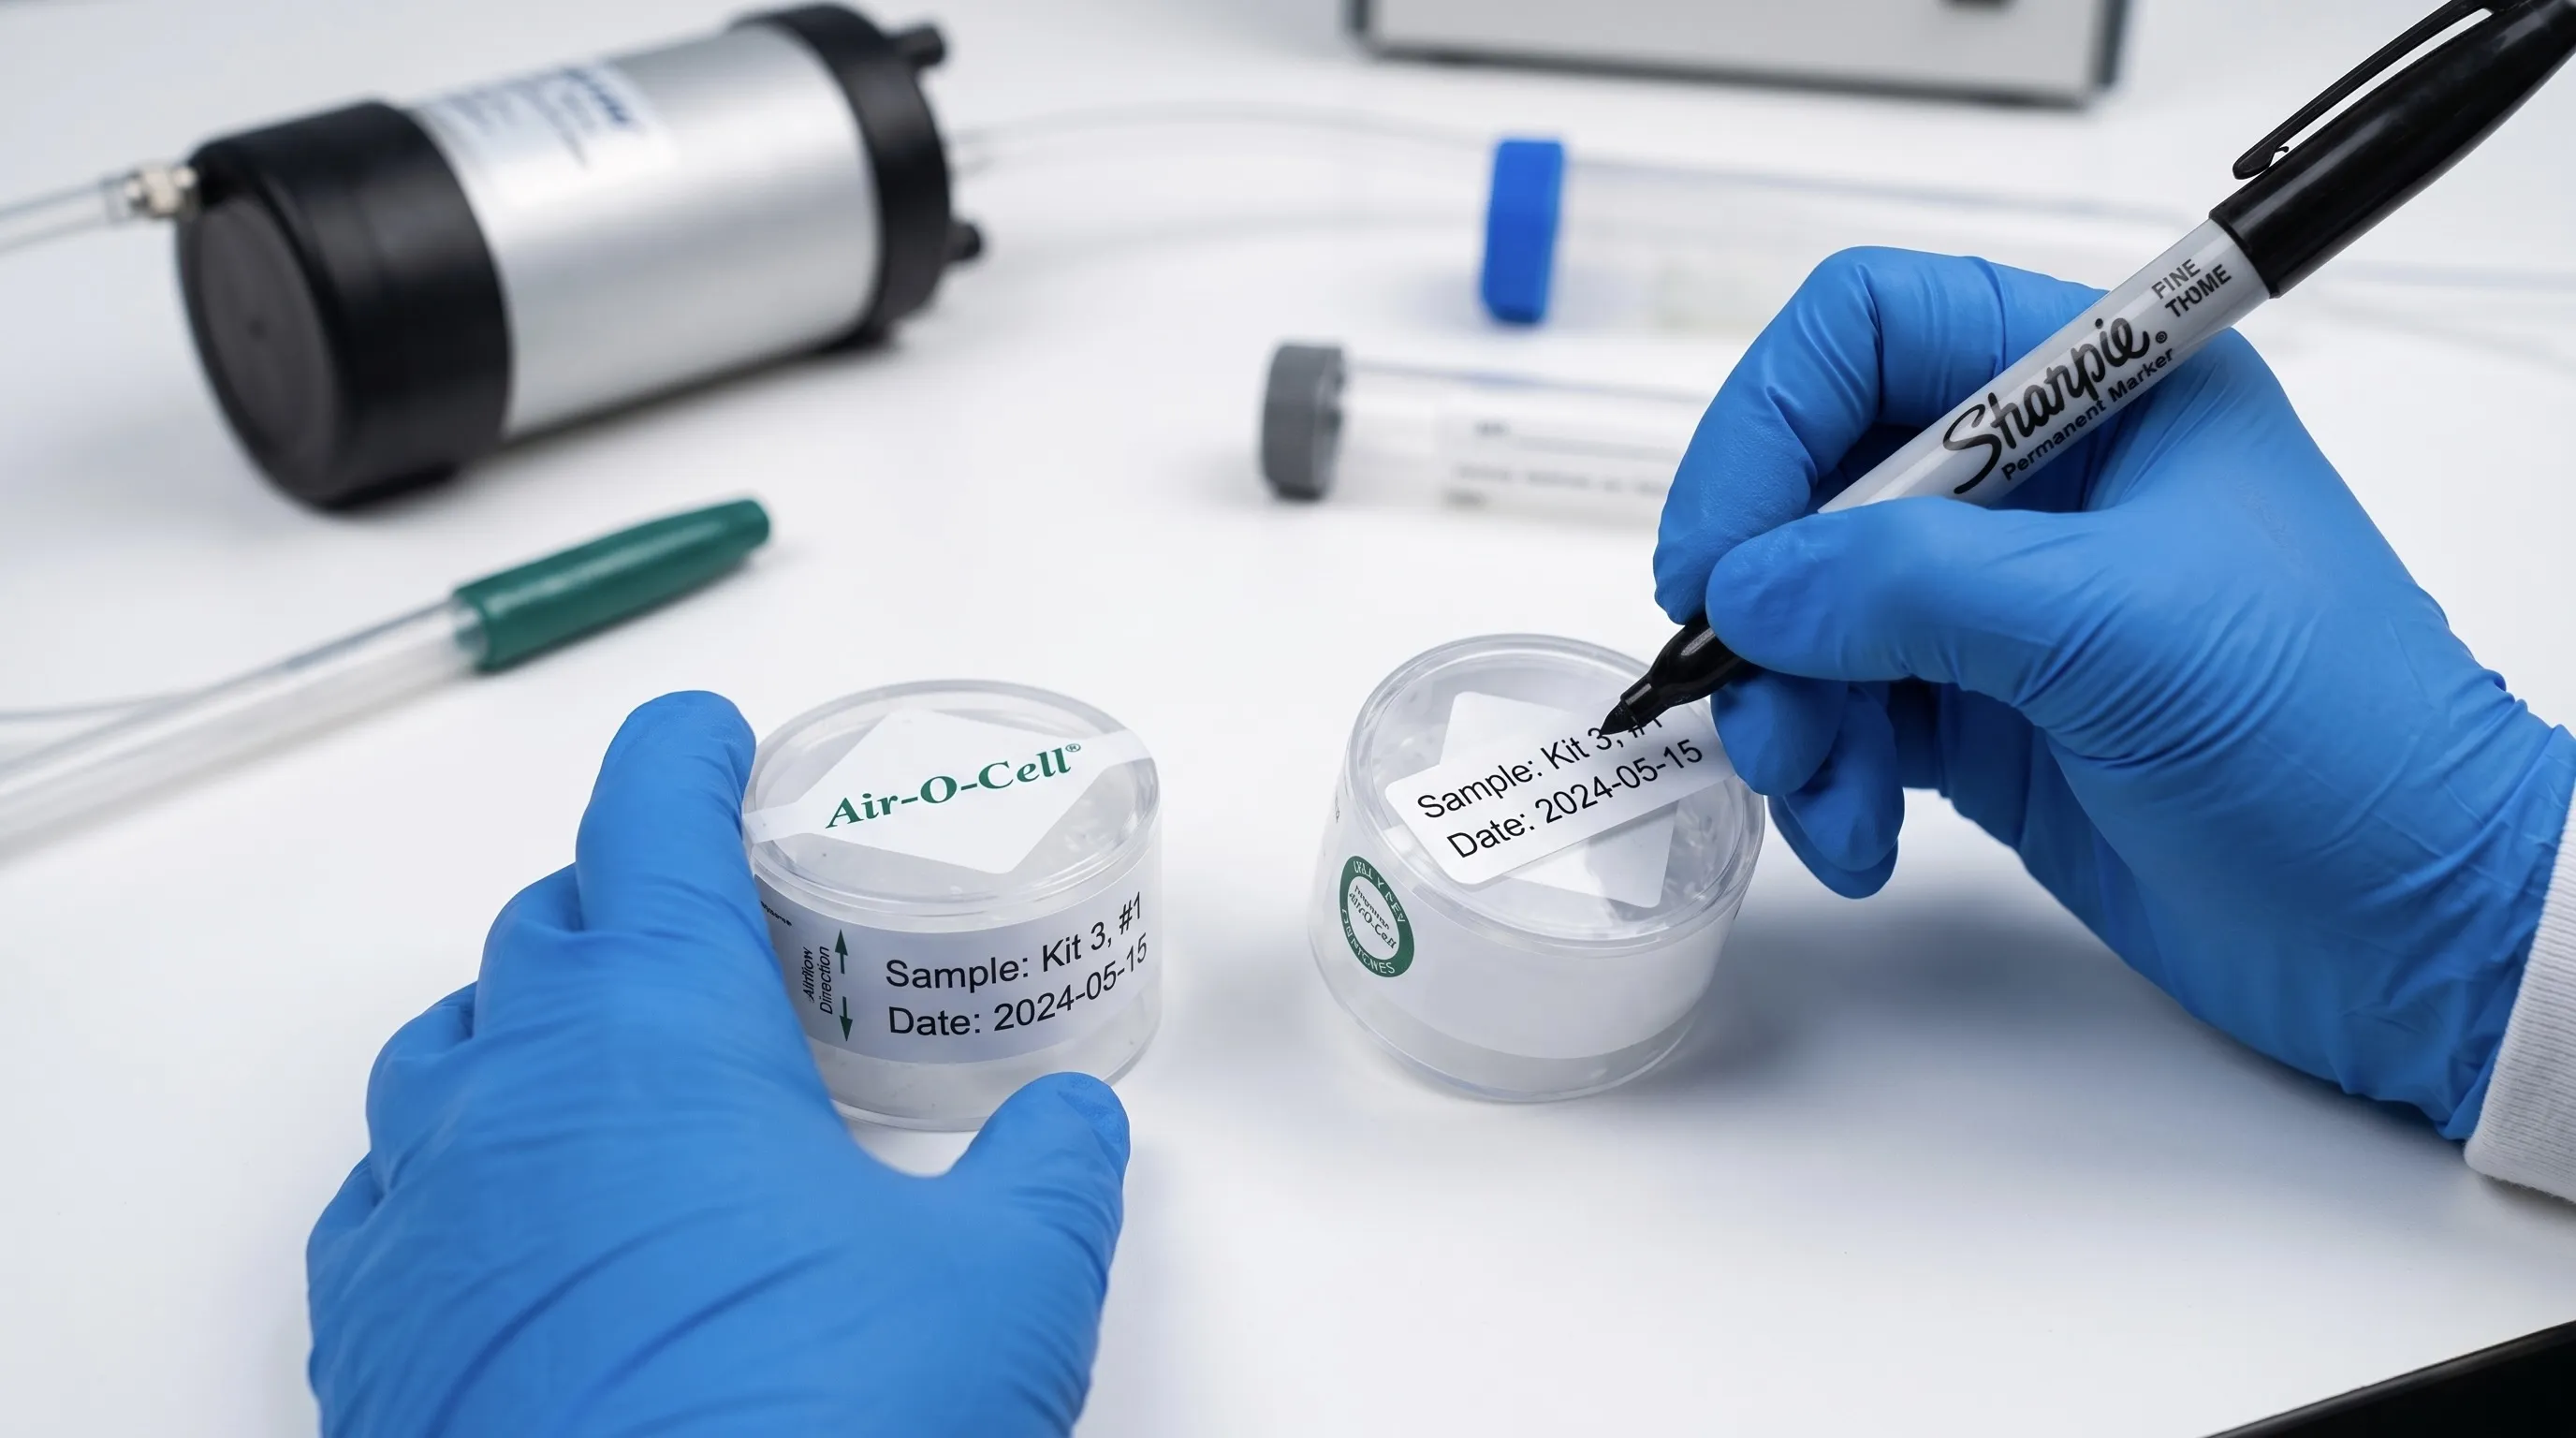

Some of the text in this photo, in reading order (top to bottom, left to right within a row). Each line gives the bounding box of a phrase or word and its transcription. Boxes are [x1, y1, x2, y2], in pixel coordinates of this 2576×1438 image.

[2151, 257, 2202, 301] FINE
[2000, 347, 2174, 481] Permanent Marker
[1417, 760, 1543, 818] Sample:
[1540, 737, 1590, 770] Kit
[1587, 727, 1624, 751] 3,
[1446, 739, 1703, 858] Date: 2024-05-15
[886, 890, 1141, 993] Sample: Kit 3, #1
[888, 932, 1148, 1036] Date: 2024-05-15
